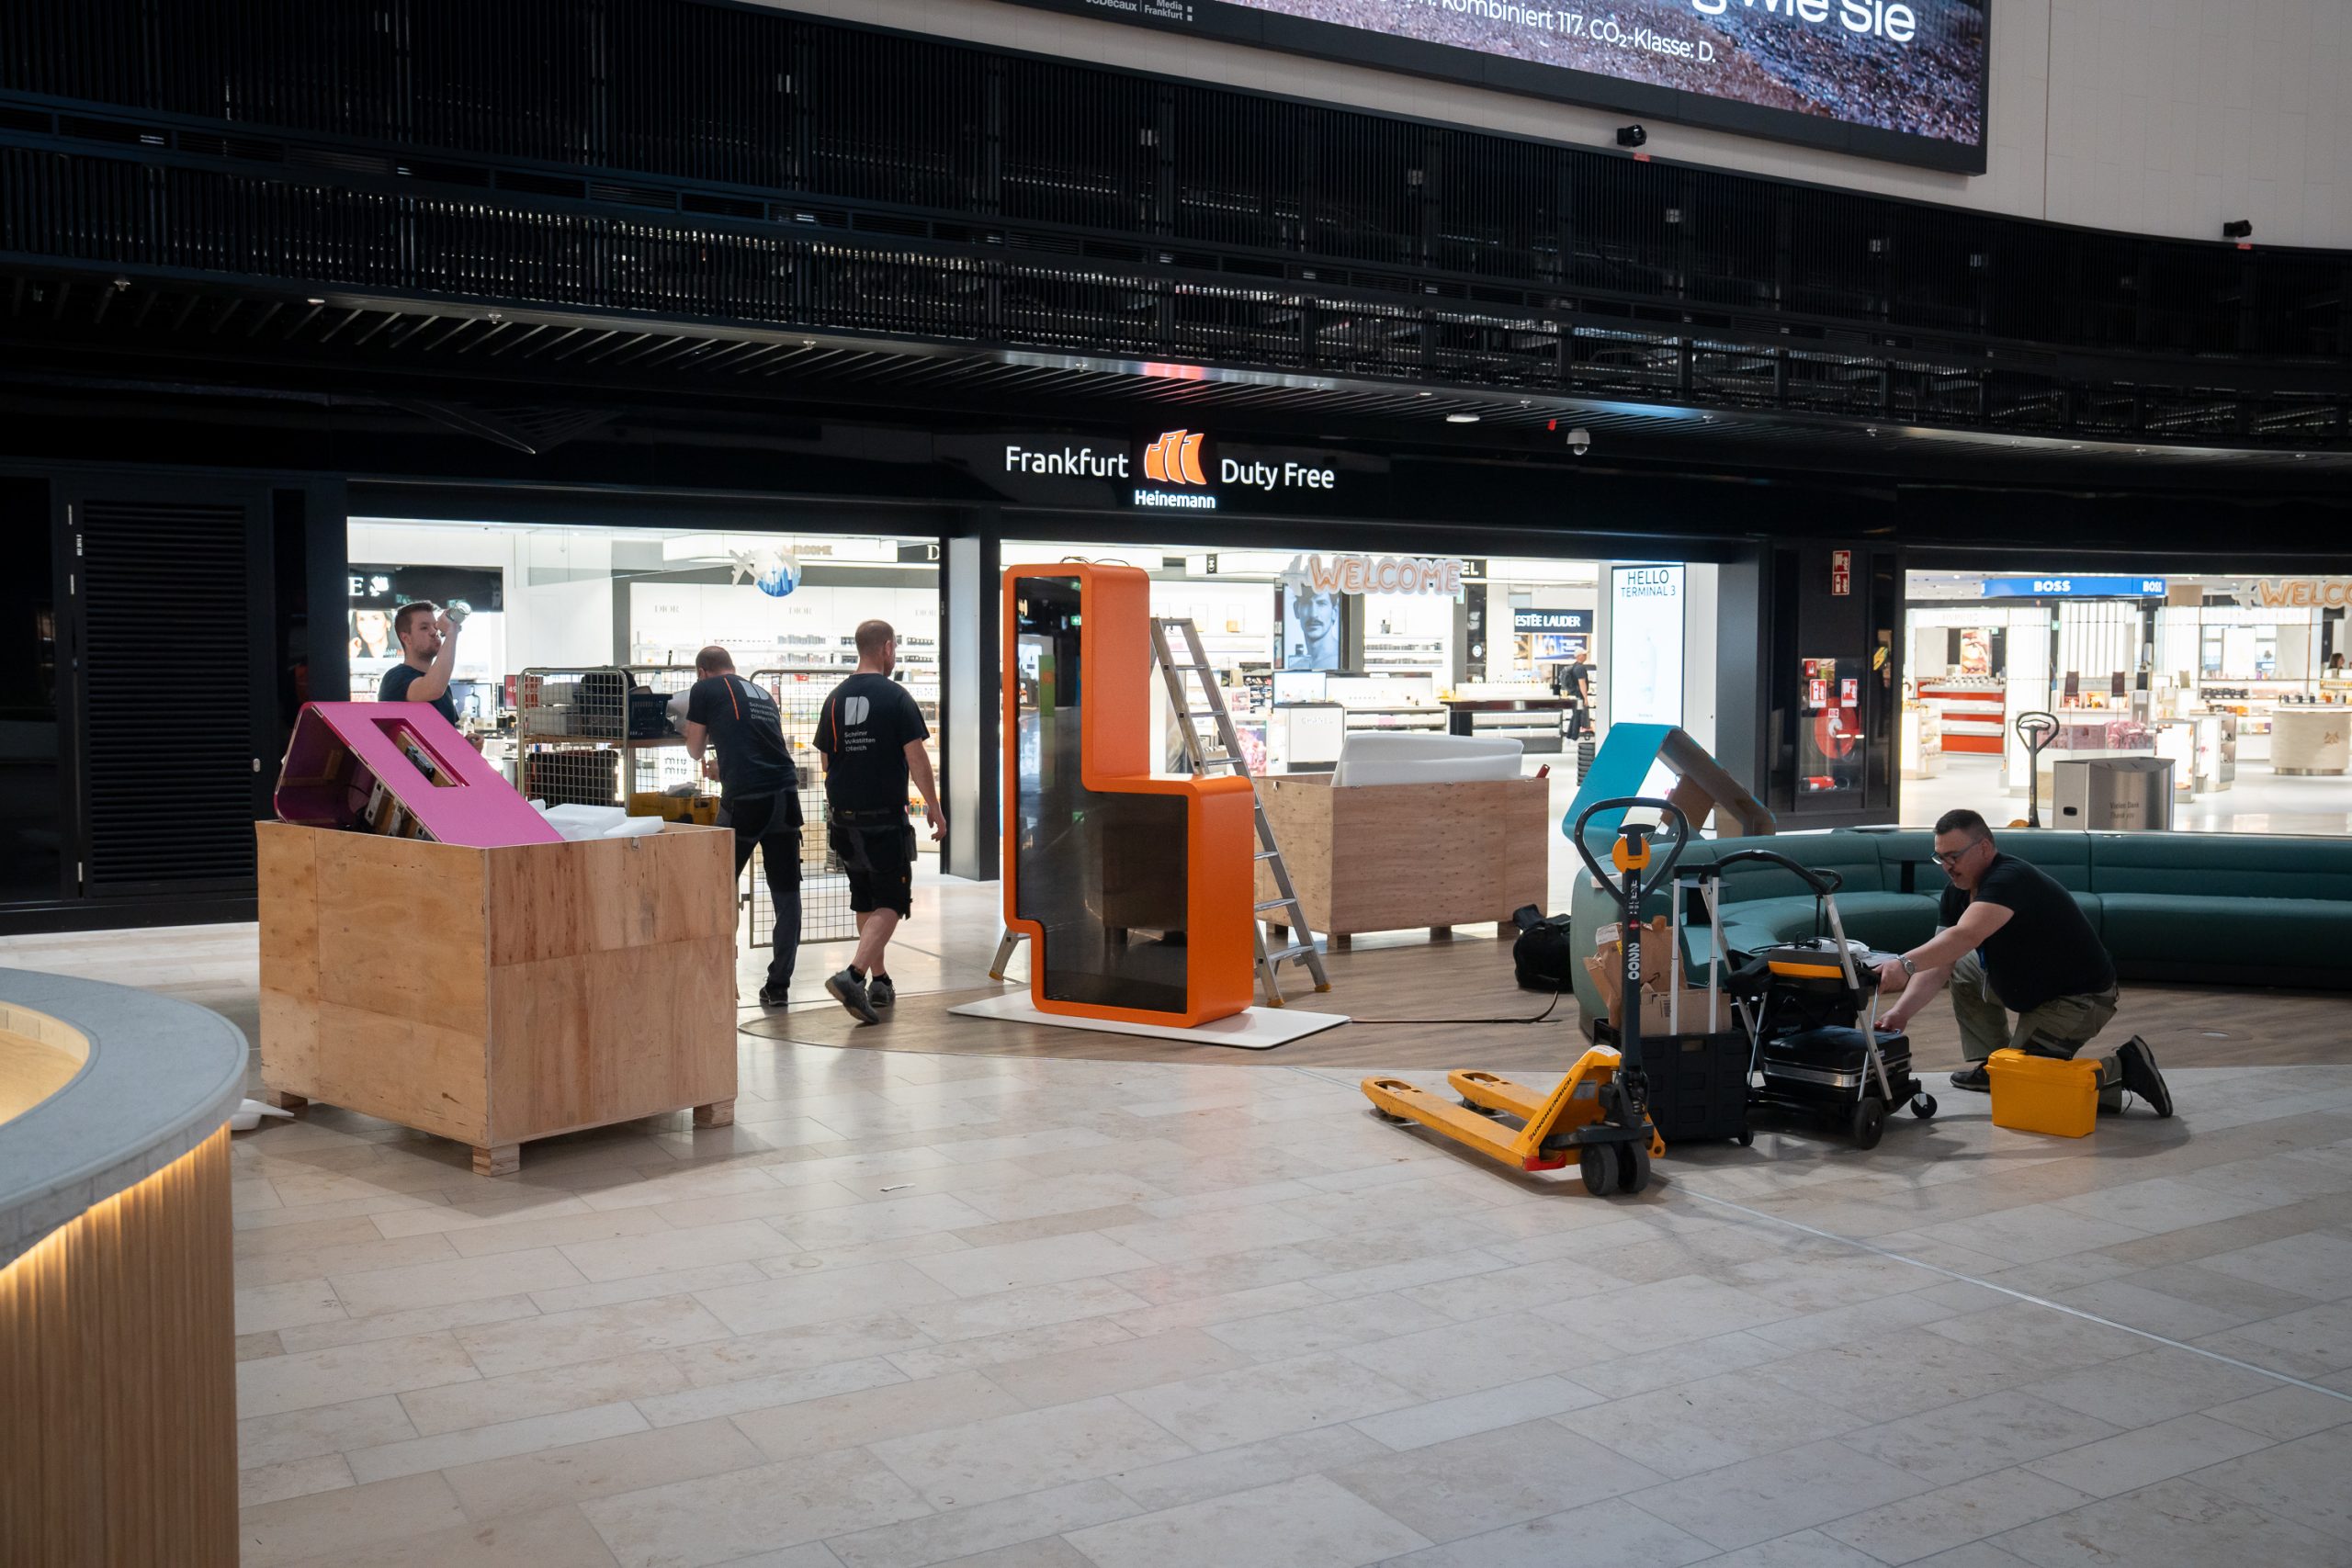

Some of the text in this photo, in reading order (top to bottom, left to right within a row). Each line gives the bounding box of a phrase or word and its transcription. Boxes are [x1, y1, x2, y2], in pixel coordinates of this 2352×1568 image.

[1086, 0, 1137, 11] Decaux
[1157, 0, 1182, 11] Media
[1145, 5, 1183, 20] Frankfurt
[1698, 40, 1716, 63] D.
[1006, 446, 1335, 491] Frankfurt Duty Free
[1135, 490, 1216, 509] Heinemann
[1308, 554, 1464, 595] WELCOME
[1627, 570, 1669, 585] HELLO
[1621, 585, 1677, 597] TERMINAL 3
[2033, 580, 2072, 592] BOSS
[2143, 581, 2163, 593] BOSS
[1544, 615, 1581, 627] LAUDER
[664, 757, 687, 765] miu
[664, 767, 687, 775] miu
[1627, 942, 1640, 980] 2200
[1528, 1077, 1574, 1142] JUNGHEINRICH
